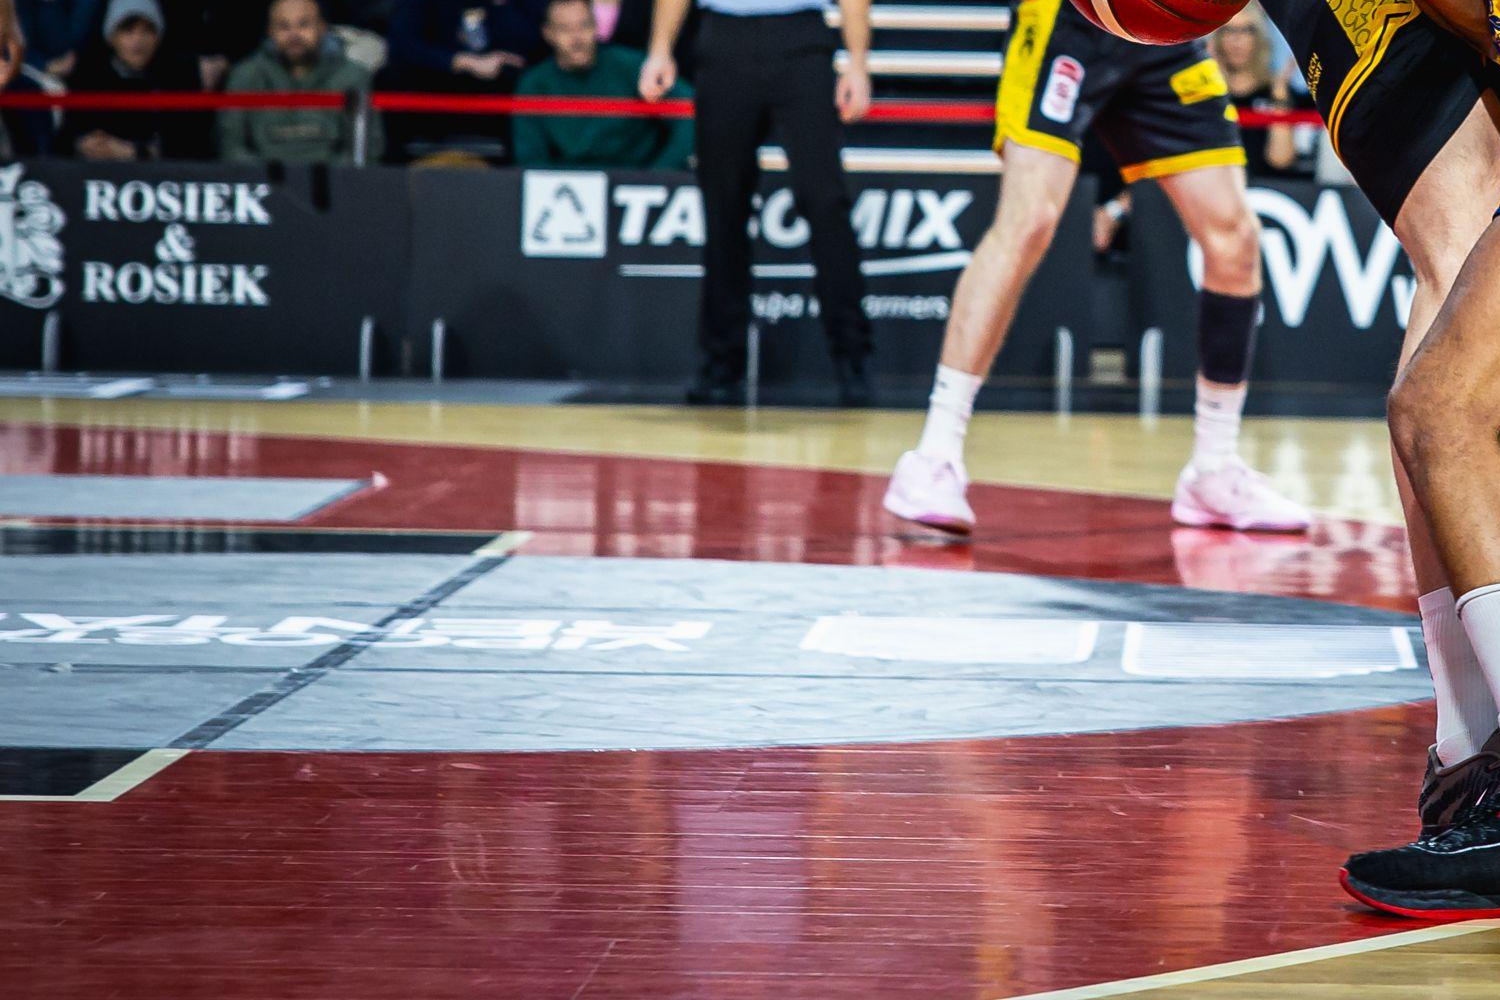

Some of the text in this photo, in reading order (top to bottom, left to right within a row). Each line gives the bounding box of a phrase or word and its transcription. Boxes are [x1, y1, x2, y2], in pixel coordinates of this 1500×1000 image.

[84, 179, 272, 225] ROSIEK
[154, 224, 196, 263] &
[82, 260, 270, 307] ROSIEK
